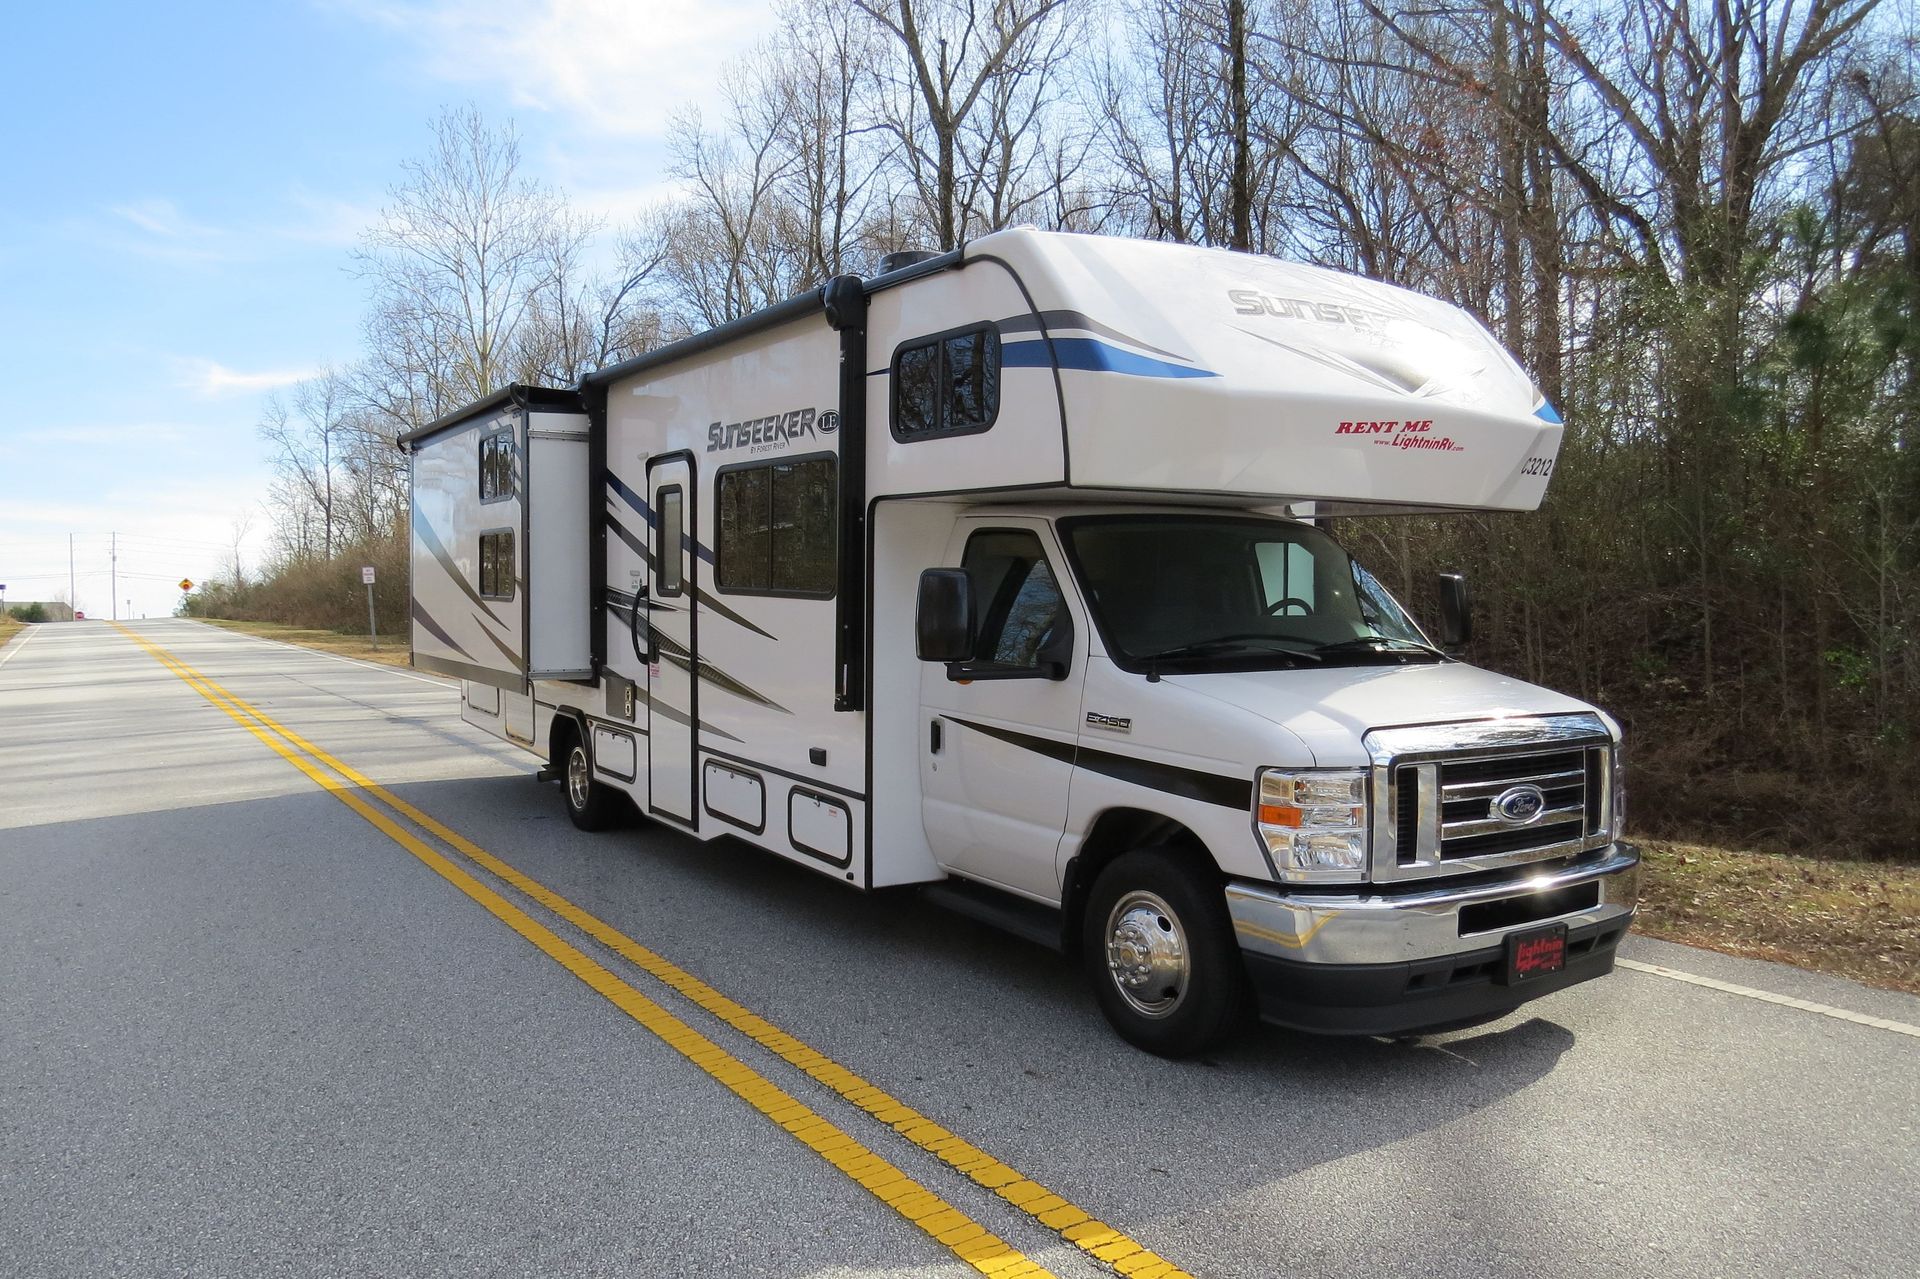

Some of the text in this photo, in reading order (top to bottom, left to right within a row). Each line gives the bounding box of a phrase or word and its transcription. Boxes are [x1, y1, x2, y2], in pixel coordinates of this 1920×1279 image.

[821, 414, 837, 430] LE
[1335, 420, 1433, 434] RENT ME
[1512, 796, 1536, 814] Ford
